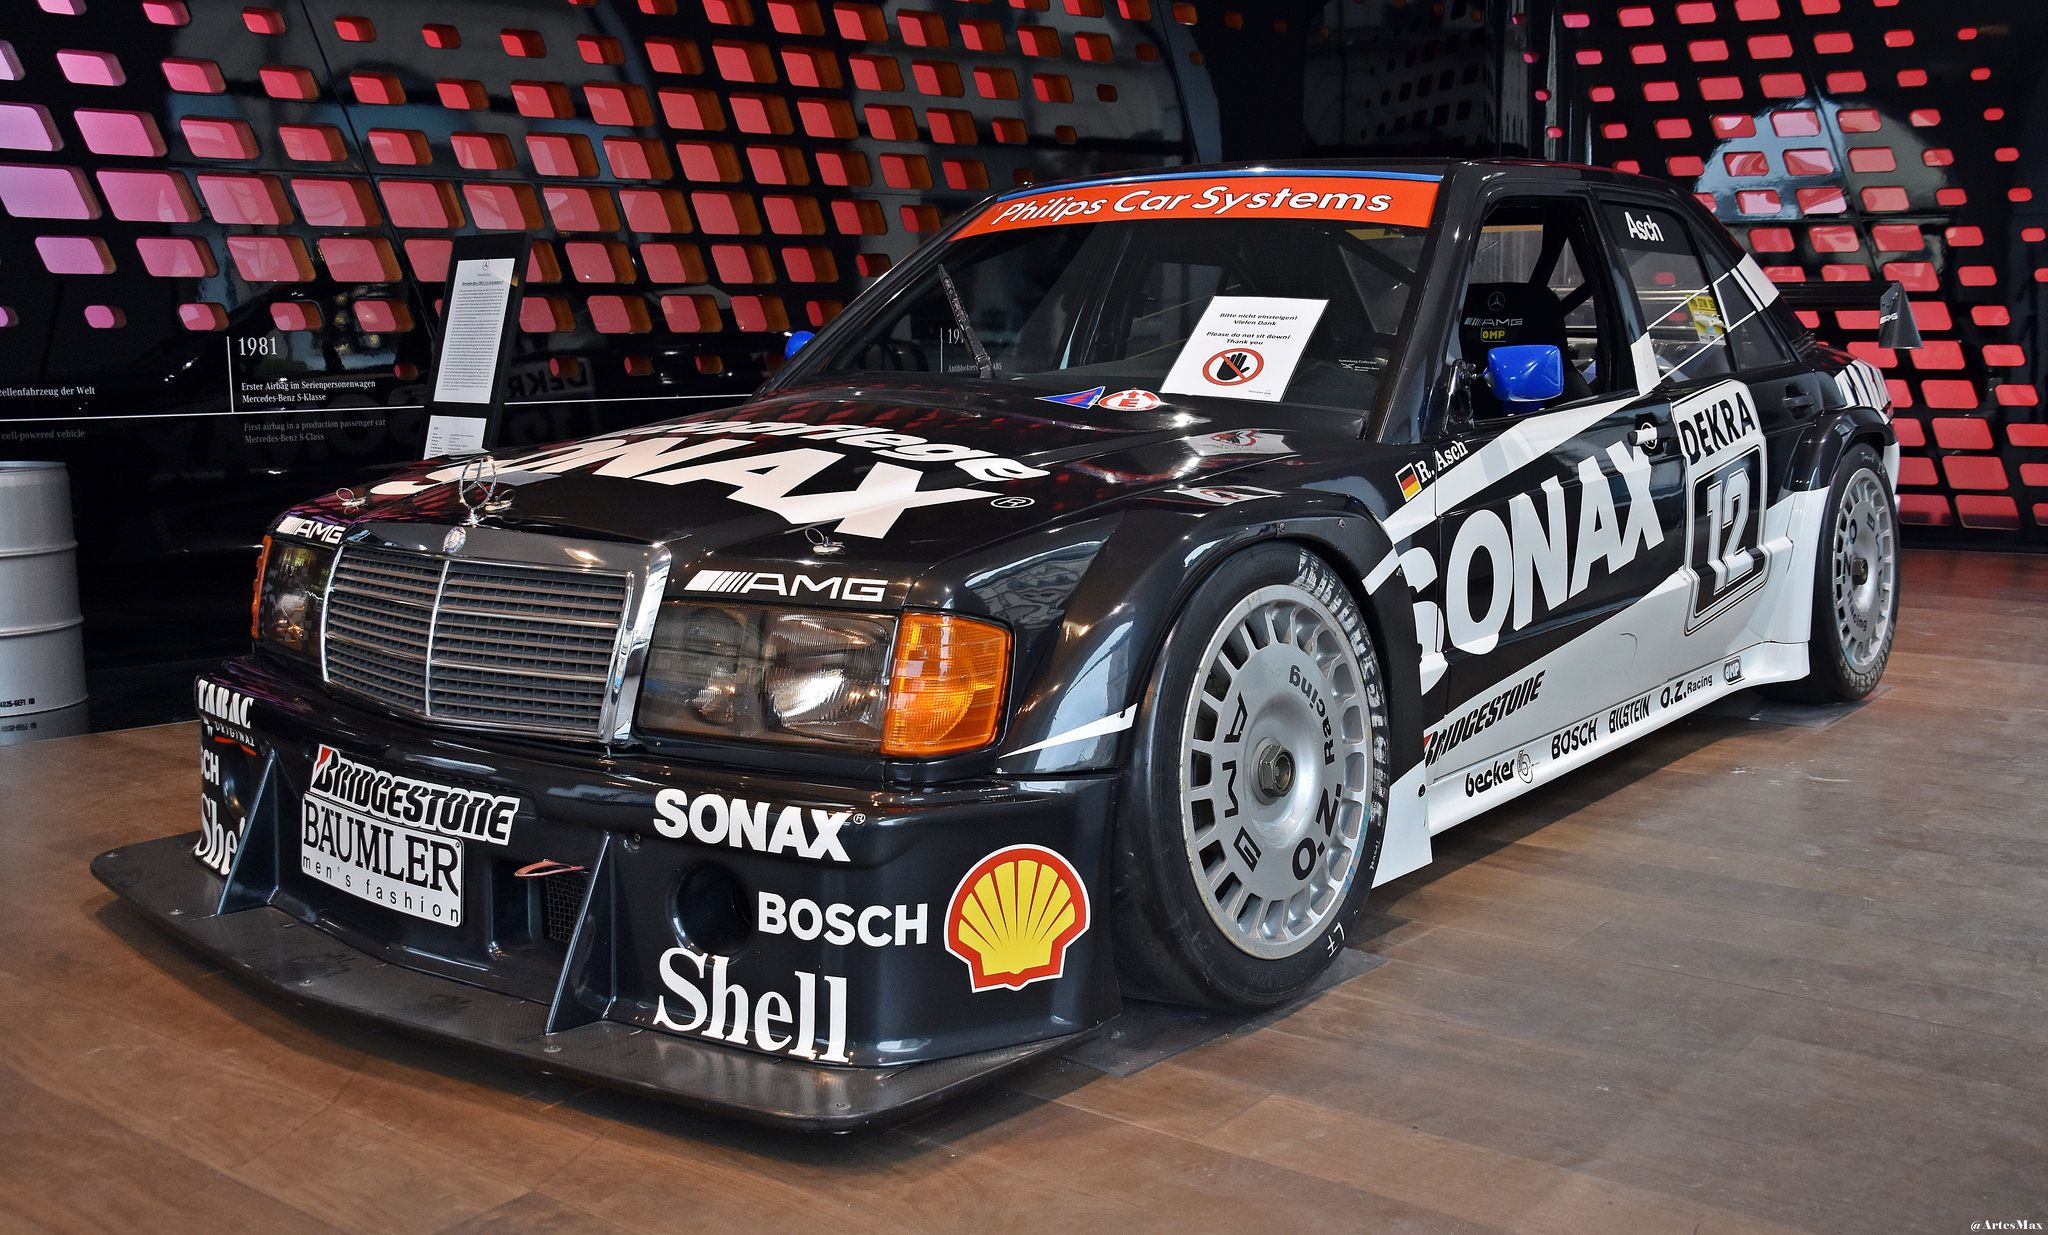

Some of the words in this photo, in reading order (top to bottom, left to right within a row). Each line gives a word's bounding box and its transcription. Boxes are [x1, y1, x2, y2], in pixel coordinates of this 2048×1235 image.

[991, 196, 1106, 226] Philips
[1113, 189, 1195, 212] Car
[1193, 185, 1395, 215] Systems
[1624, 211, 1665, 242] Asch
[1238, 312, 1257, 320] nicht
[1257, 313, 1298, 322] einsteigen!
[1257, 319, 1277, 327] Dank
[1481, 318, 1523, 327] AMG
[238, 336, 278, 357] 1981
[1482, 330, 1506, 340] OMP
[60, 386, 75, 396] der
[76, 386, 96, 395] Welt
[241, 382, 264, 391] Erster
[265, 380, 289, 392] Airbag
[290, 381, 300, 390] im
[301, 379, 376, 391] Serienpersonenwagen
[242, 394, 296, 404] Mercedes-Benz
[296, 392, 327, 402] S-Klasse
[56, 429, 86, 438] vehicle
[244, 422, 262, 432] First
[262, 421, 286, 432] airbag
[286, 421, 295, 430] in
[301, 419, 339, 431] production
[340, 419, 374, 430] passenger
[374, 419, 388, 427] car
[244, 434, 299, 444] Mercedes-Benz
[299, 433, 325, 442] S-Class
[1678, 391, 1757, 466] DEKRA
[1414, 460, 1436, 483] R.
[1434, 440, 1469, 472] Asch
[296, 519, 347, 544] AMG
[1706, 466, 1754, 597] 12
[739, 572, 889, 603] AMG
[1687, 674, 1713, 695] Racing
[1724, 662, 1740, 680] OMP
[197, 678, 255, 730] TABAC
[1287, 663, 1336, 767] Racing
[1425, 669, 1547, 768] BRIDGESTONE
[1607, 694, 1651, 734] BILSTEIN
[214, 719, 256, 748] ORIGINAL
[1550, 717, 1599, 761] BOSCH
[1465, 758, 1516, 798] becker
[308, 743, 520, 846] BRIDGESTONE
[303, 798, 460, 898] BÄUMLER
[365, 877, 460, 923] fashion
[758, 891, 929, 948] BOSCH
[652, 946, 851, 1064] Shell
